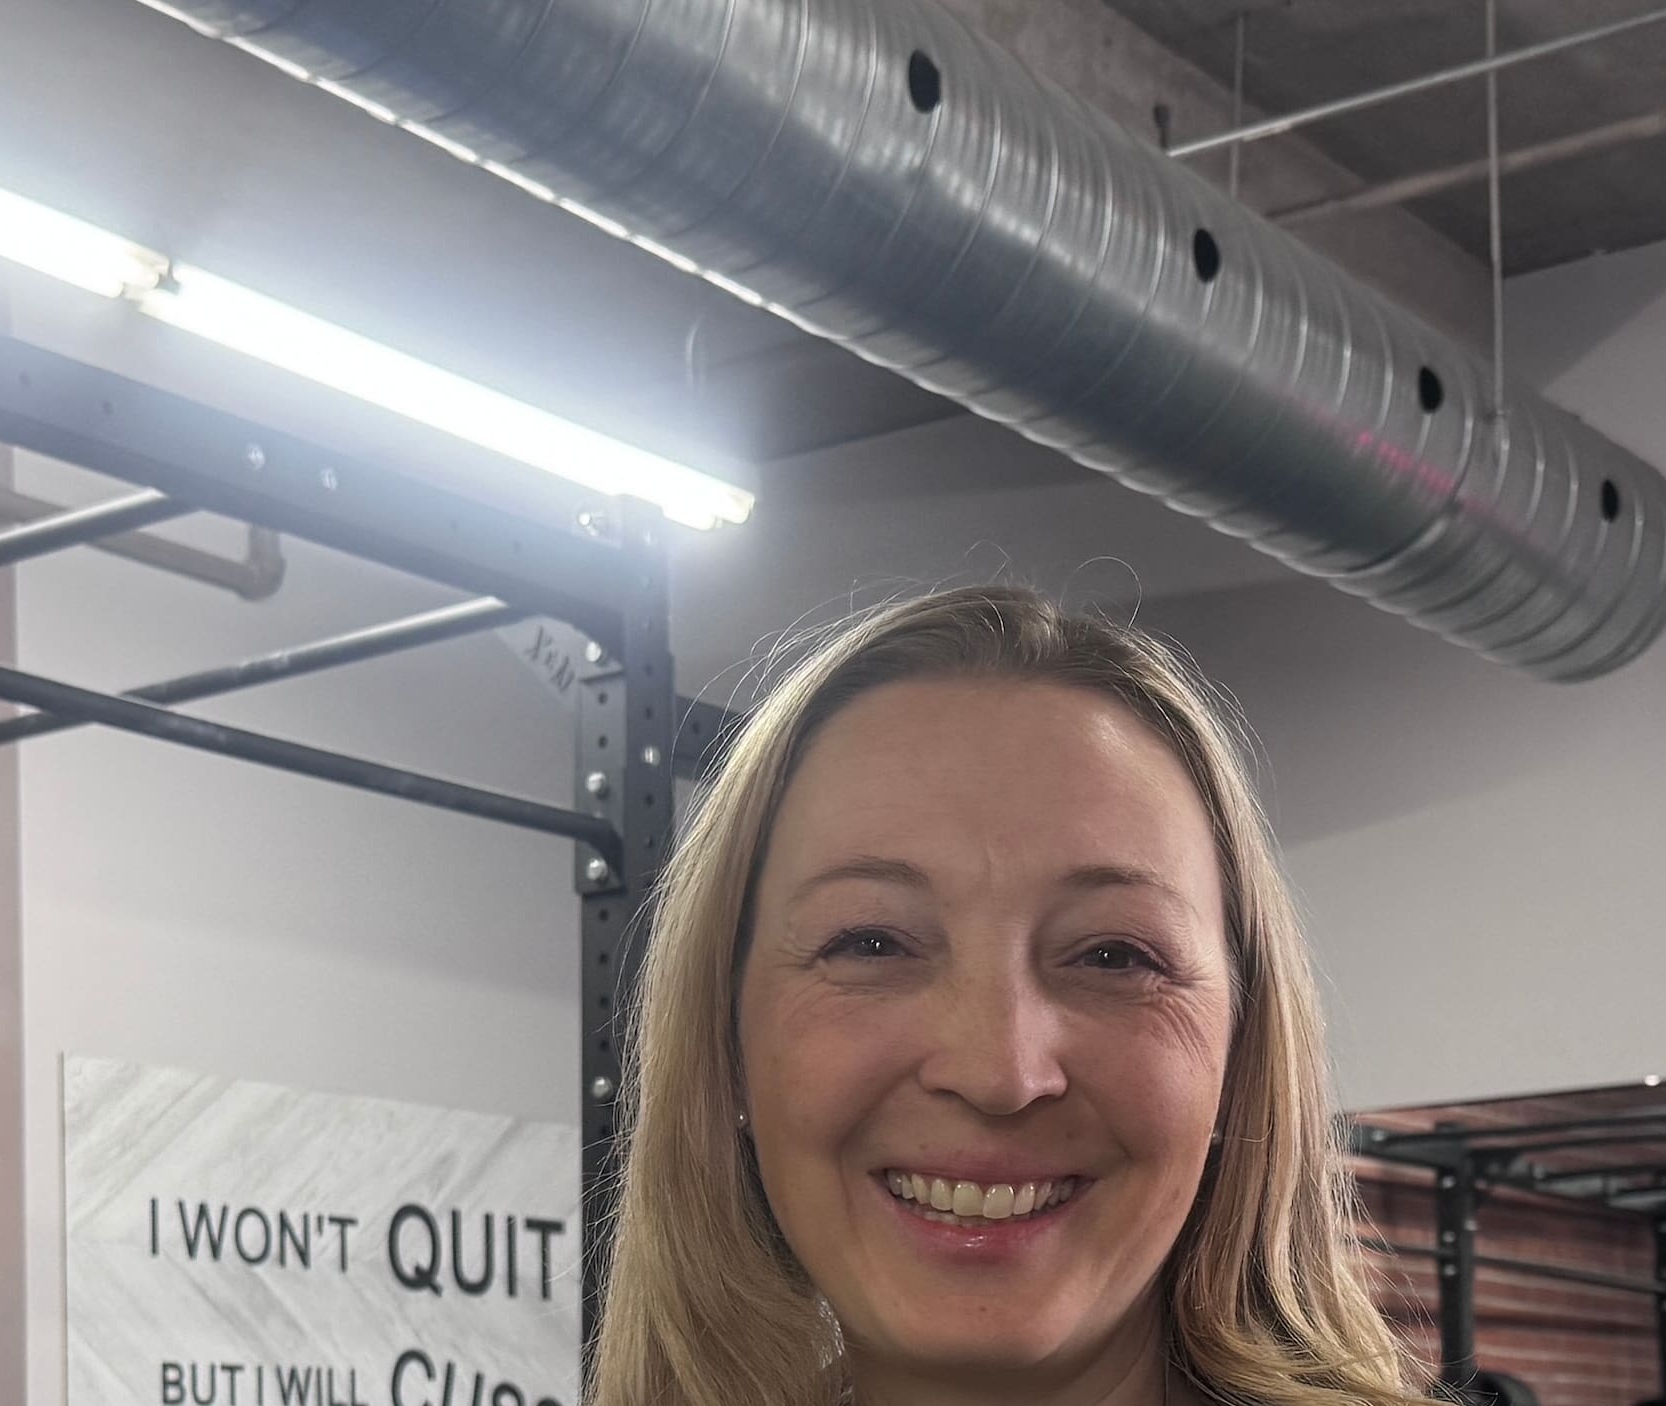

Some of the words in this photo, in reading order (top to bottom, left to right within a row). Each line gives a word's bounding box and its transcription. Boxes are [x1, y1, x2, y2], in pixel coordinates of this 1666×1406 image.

[149, 1198, 160, 1258] I
[178, 1199, 358, 1273] WON'T
[387, 1203, 566, 1300] QUIT
[162, 1361, 243, 1406] BUT
[256, 1364, 264, 1406] I
